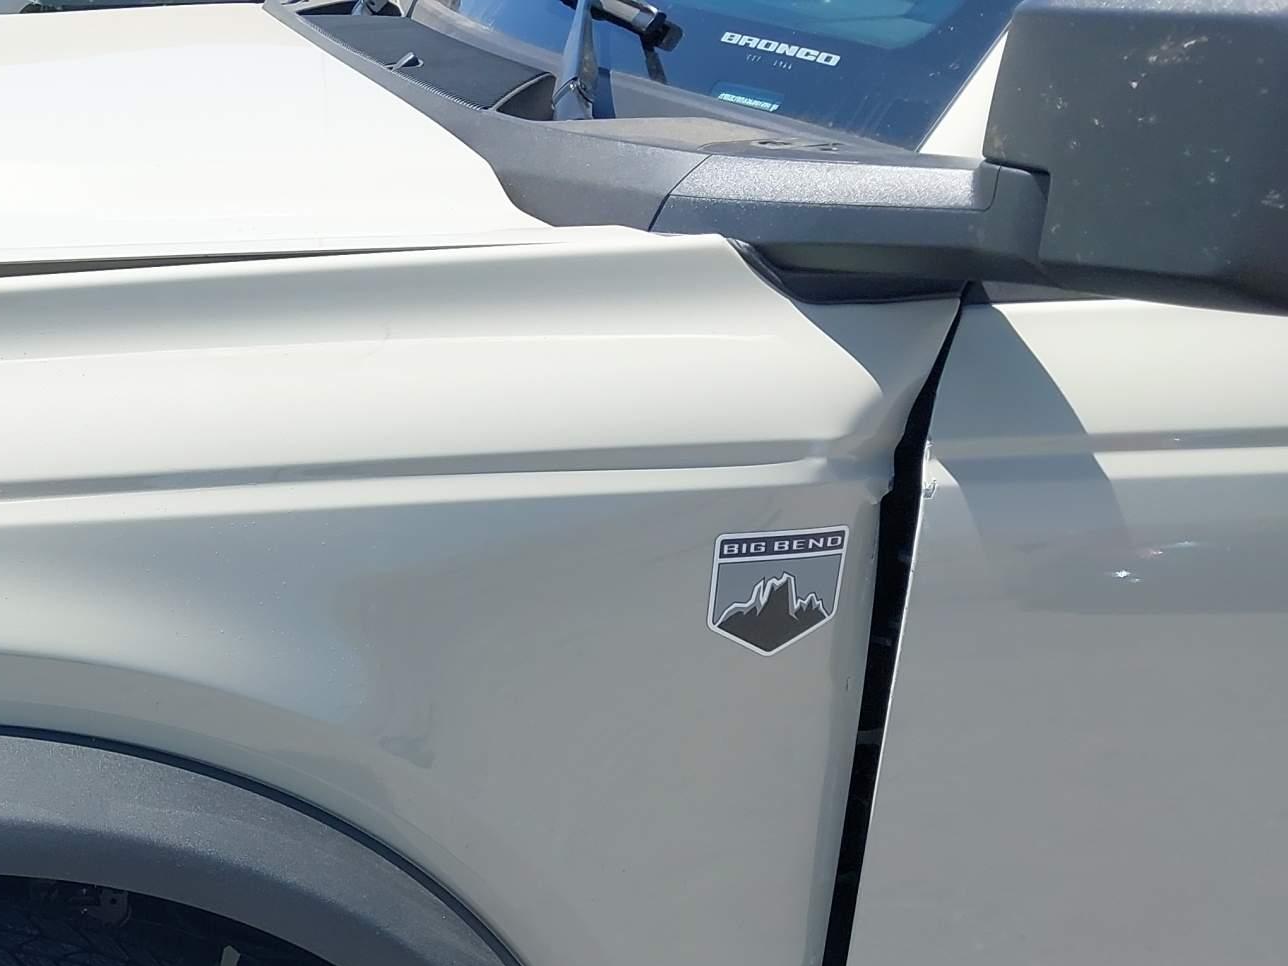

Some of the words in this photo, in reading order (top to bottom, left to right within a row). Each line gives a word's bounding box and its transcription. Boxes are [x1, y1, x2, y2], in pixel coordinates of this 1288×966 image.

[720, 31, 842, 67] BRONCO
[723, 542, 767, 555] BIG
[773, 535, 843, 552] BEND
